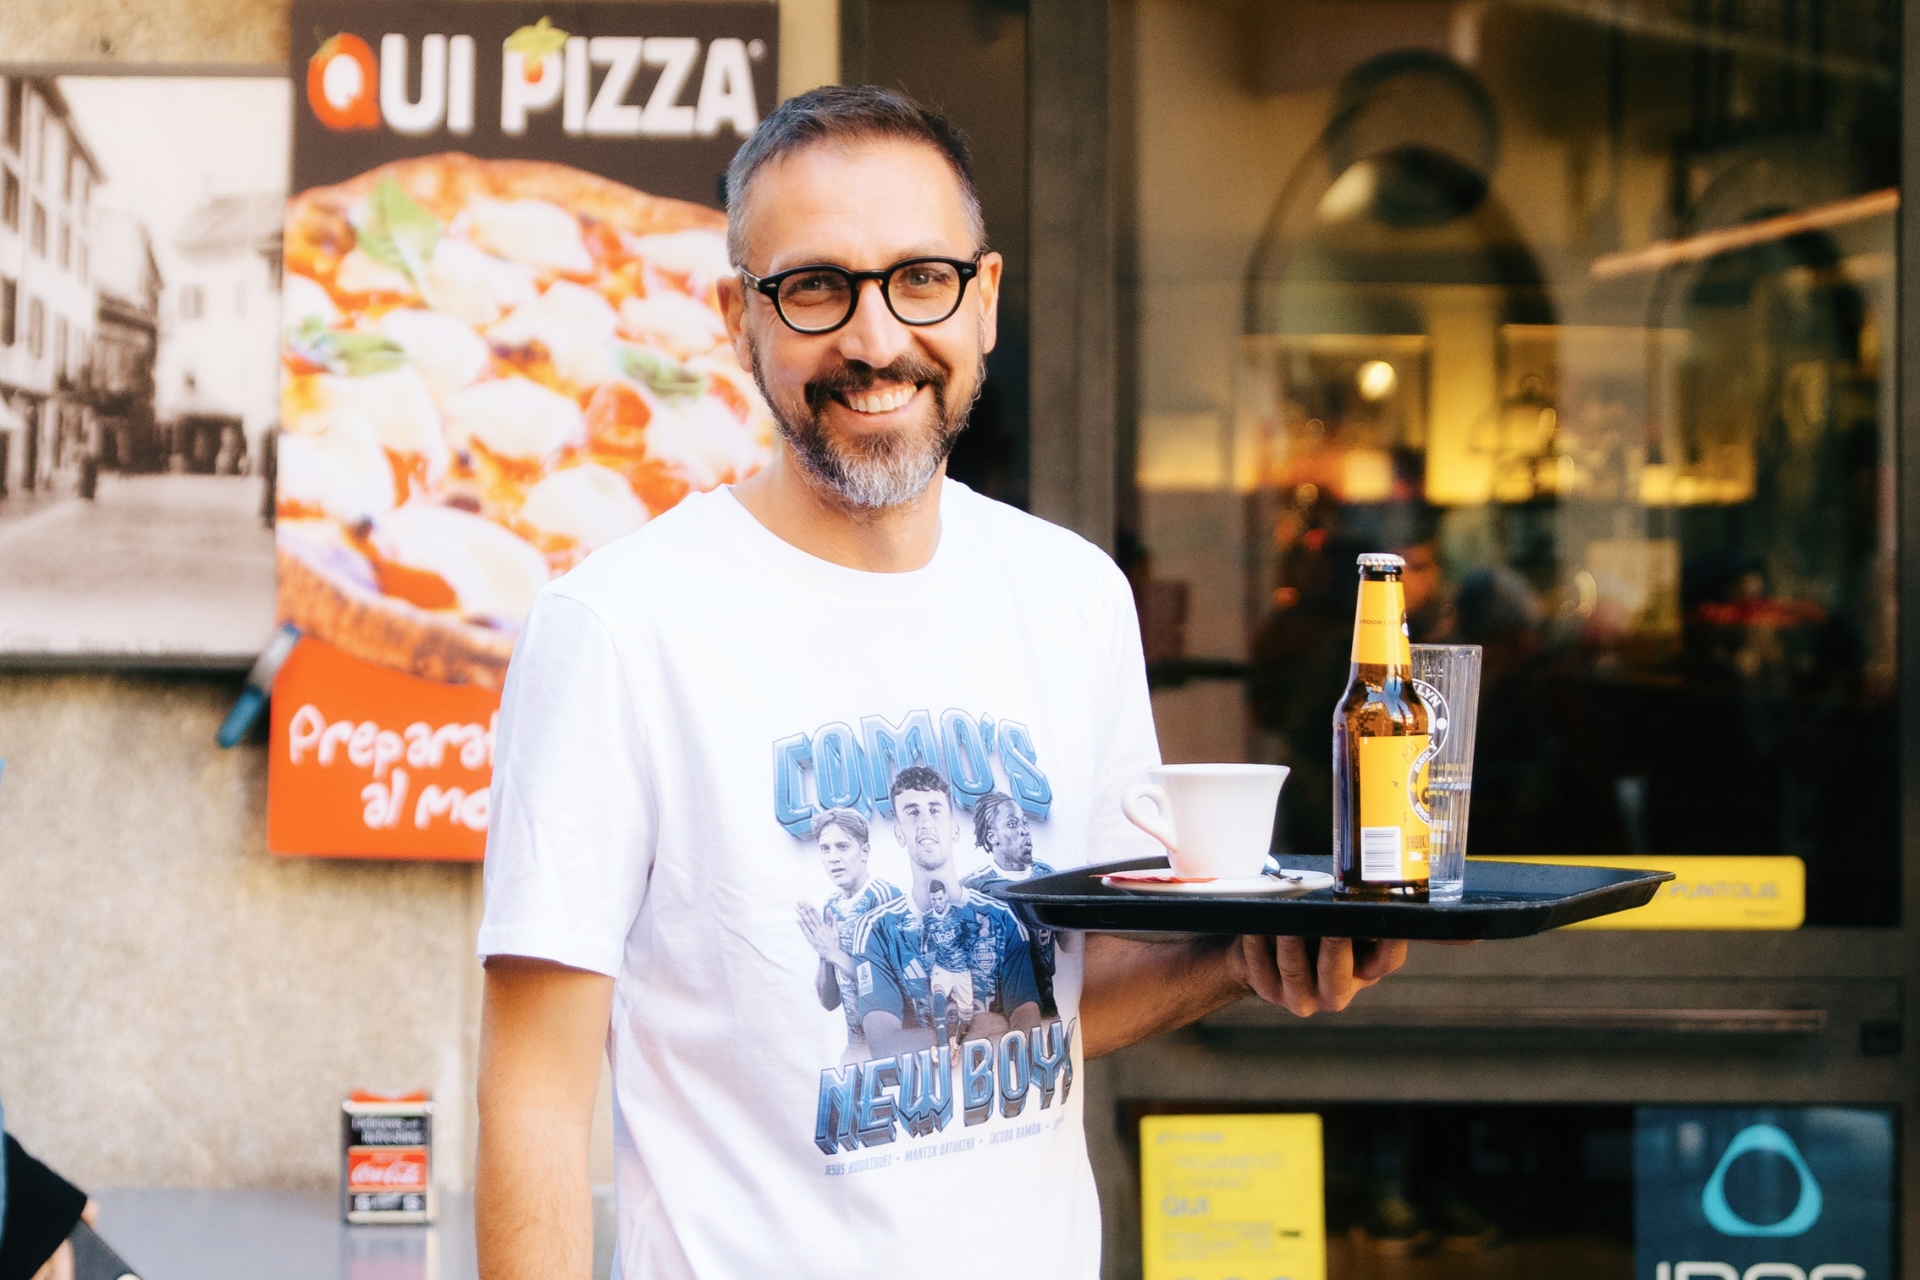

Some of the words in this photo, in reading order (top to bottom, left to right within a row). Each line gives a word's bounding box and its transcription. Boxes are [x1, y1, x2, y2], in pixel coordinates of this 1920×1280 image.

[306, 31, 475, 134] QUI
[501, 34, 761, 135] PIZZA
[1412, 682, 1442, 708] LYN
[360, 766, 410, 831] al
[772, 707, 1053, 841] COMO'S
[931, 928, 956, 944] Uber
[813, 1045, 954, 1156] NEW
